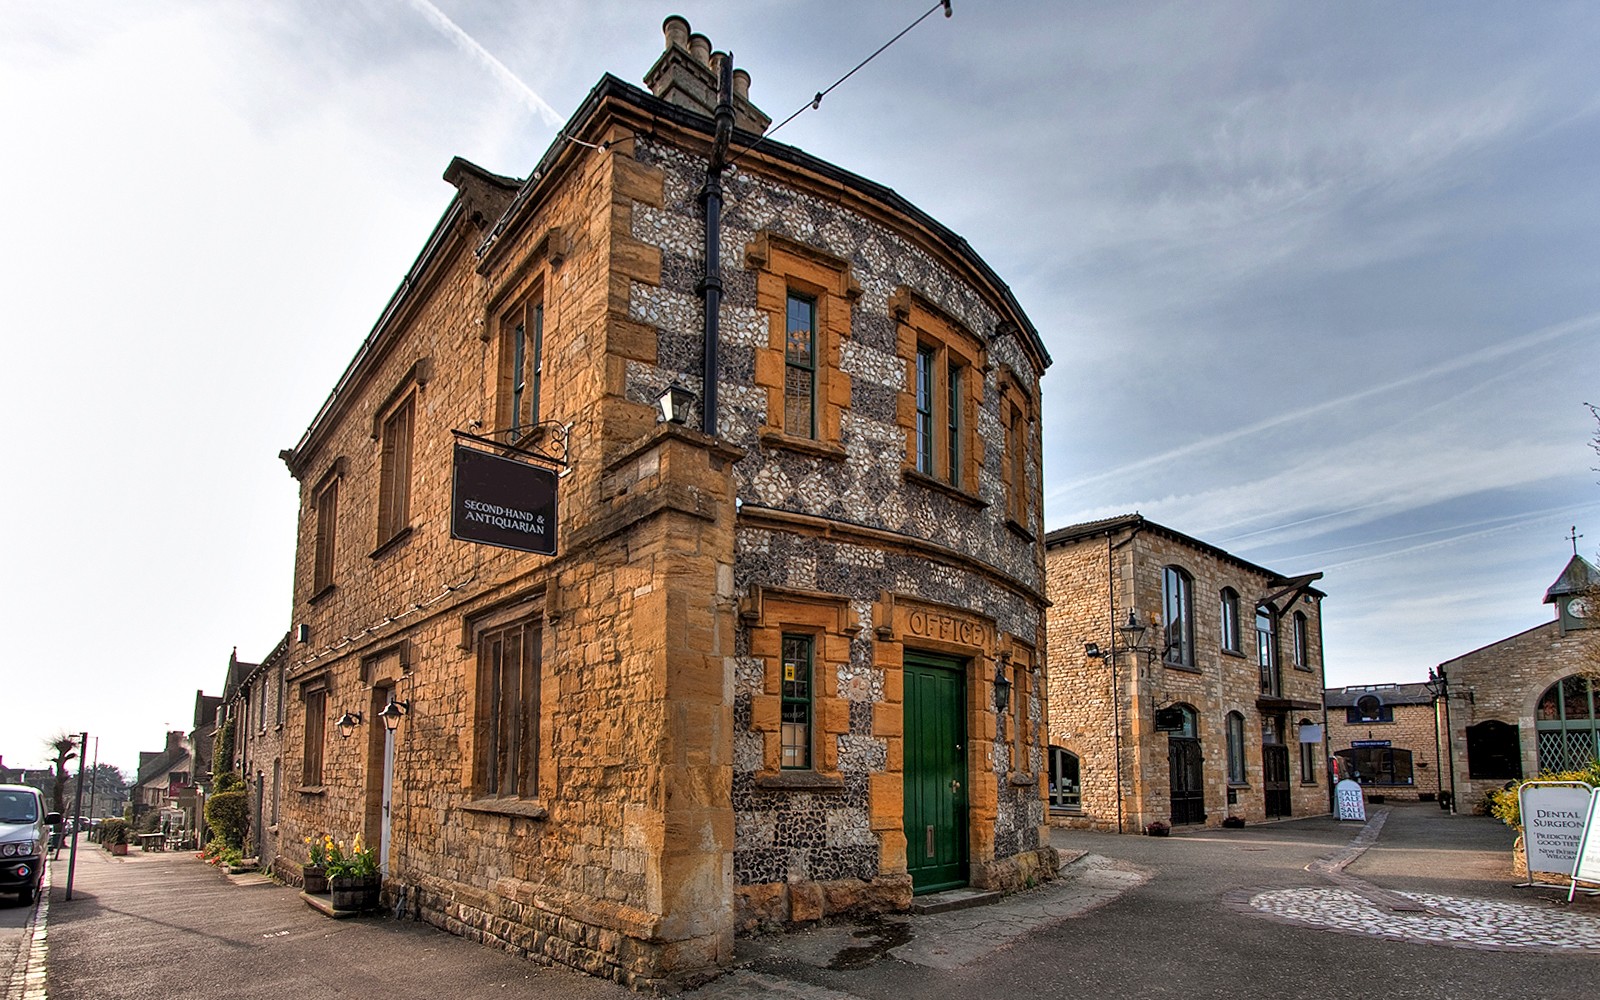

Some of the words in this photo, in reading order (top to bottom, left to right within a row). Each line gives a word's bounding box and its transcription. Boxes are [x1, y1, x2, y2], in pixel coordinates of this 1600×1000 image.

[465, 511, 545, 535] ANTIQUARIAN
[536, 514, 545, 524] &
[910, 610, 985, 646] OFFICE
[1537, 809, 1581, 818] DENTAL
[1533, 818, 1585, 828] SURGEON
